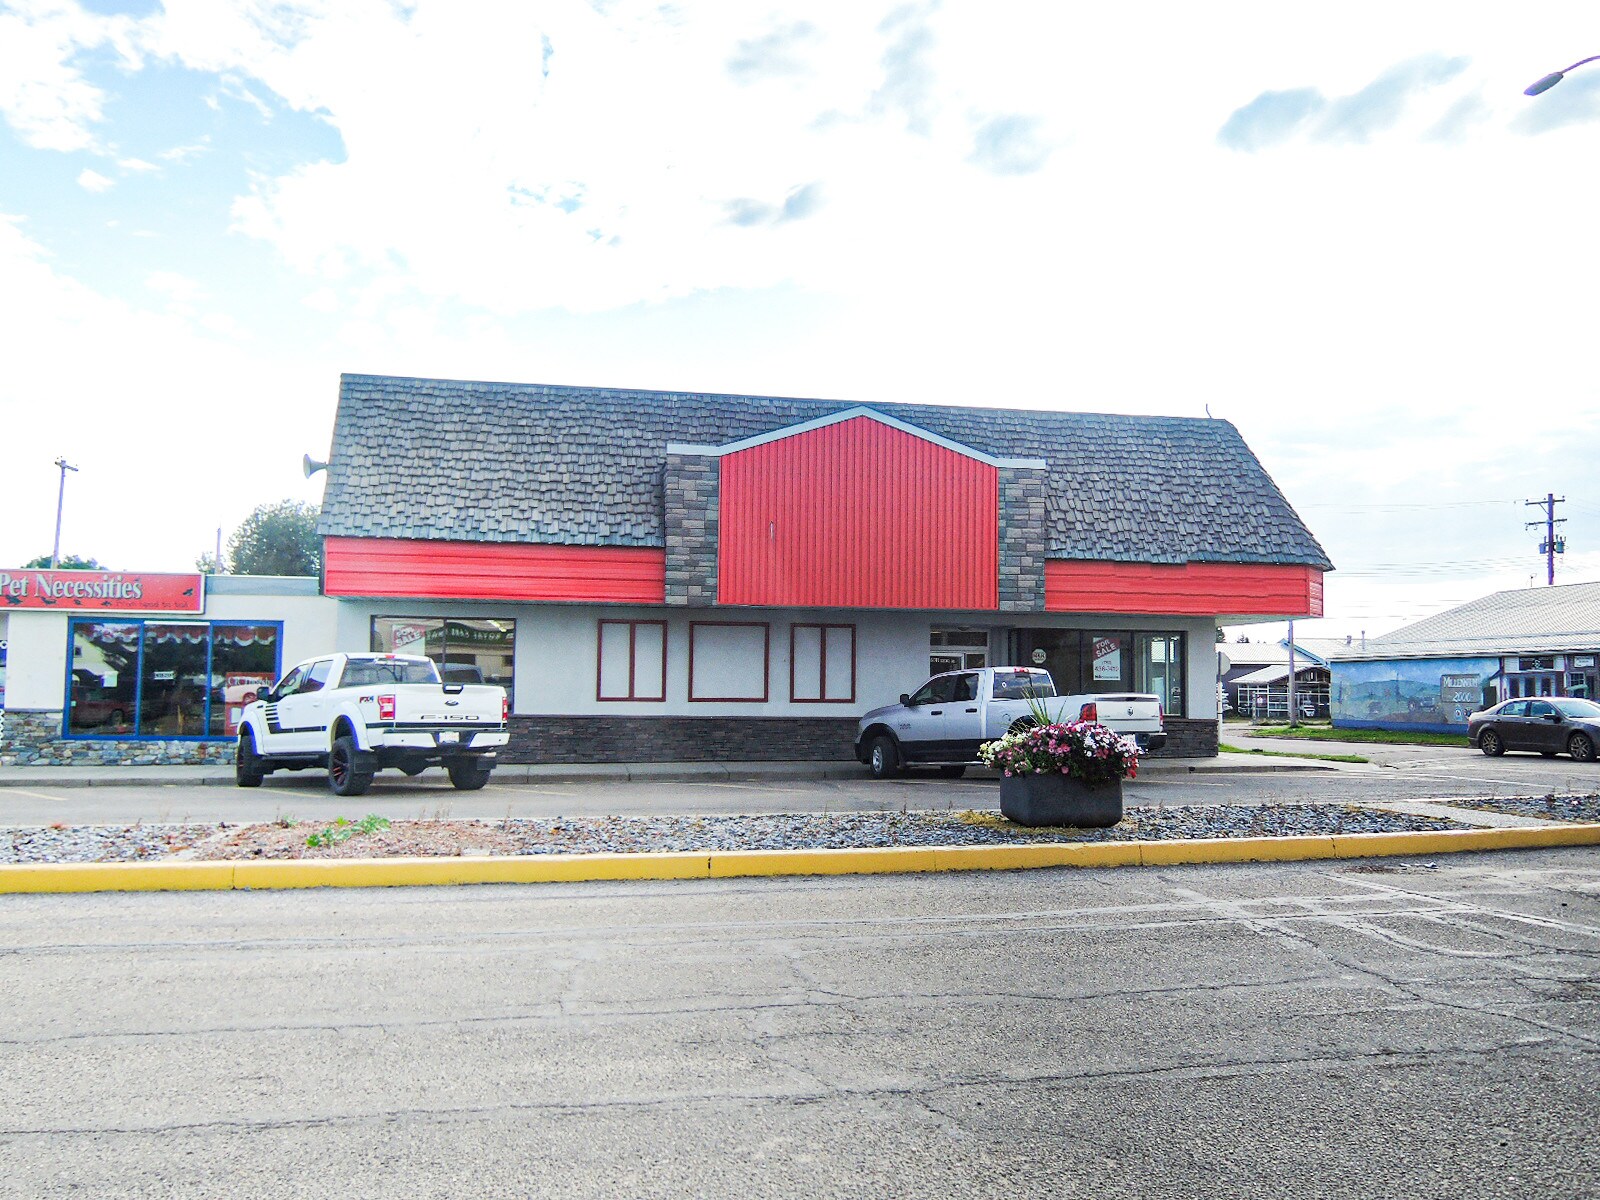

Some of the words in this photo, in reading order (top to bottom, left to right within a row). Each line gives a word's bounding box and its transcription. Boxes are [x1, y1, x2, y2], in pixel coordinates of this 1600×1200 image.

[0, 573, 29, 597] Pet
[34, 573, 143, 599] Necessities
[395, 626, 415, 637] FOR
[395, 630, 422, 647] SALE
[1096, 639, 1110, 649] FOR
[1095, 643, 1116, 657] SALE
[359, 695, 375, 703] FX4
